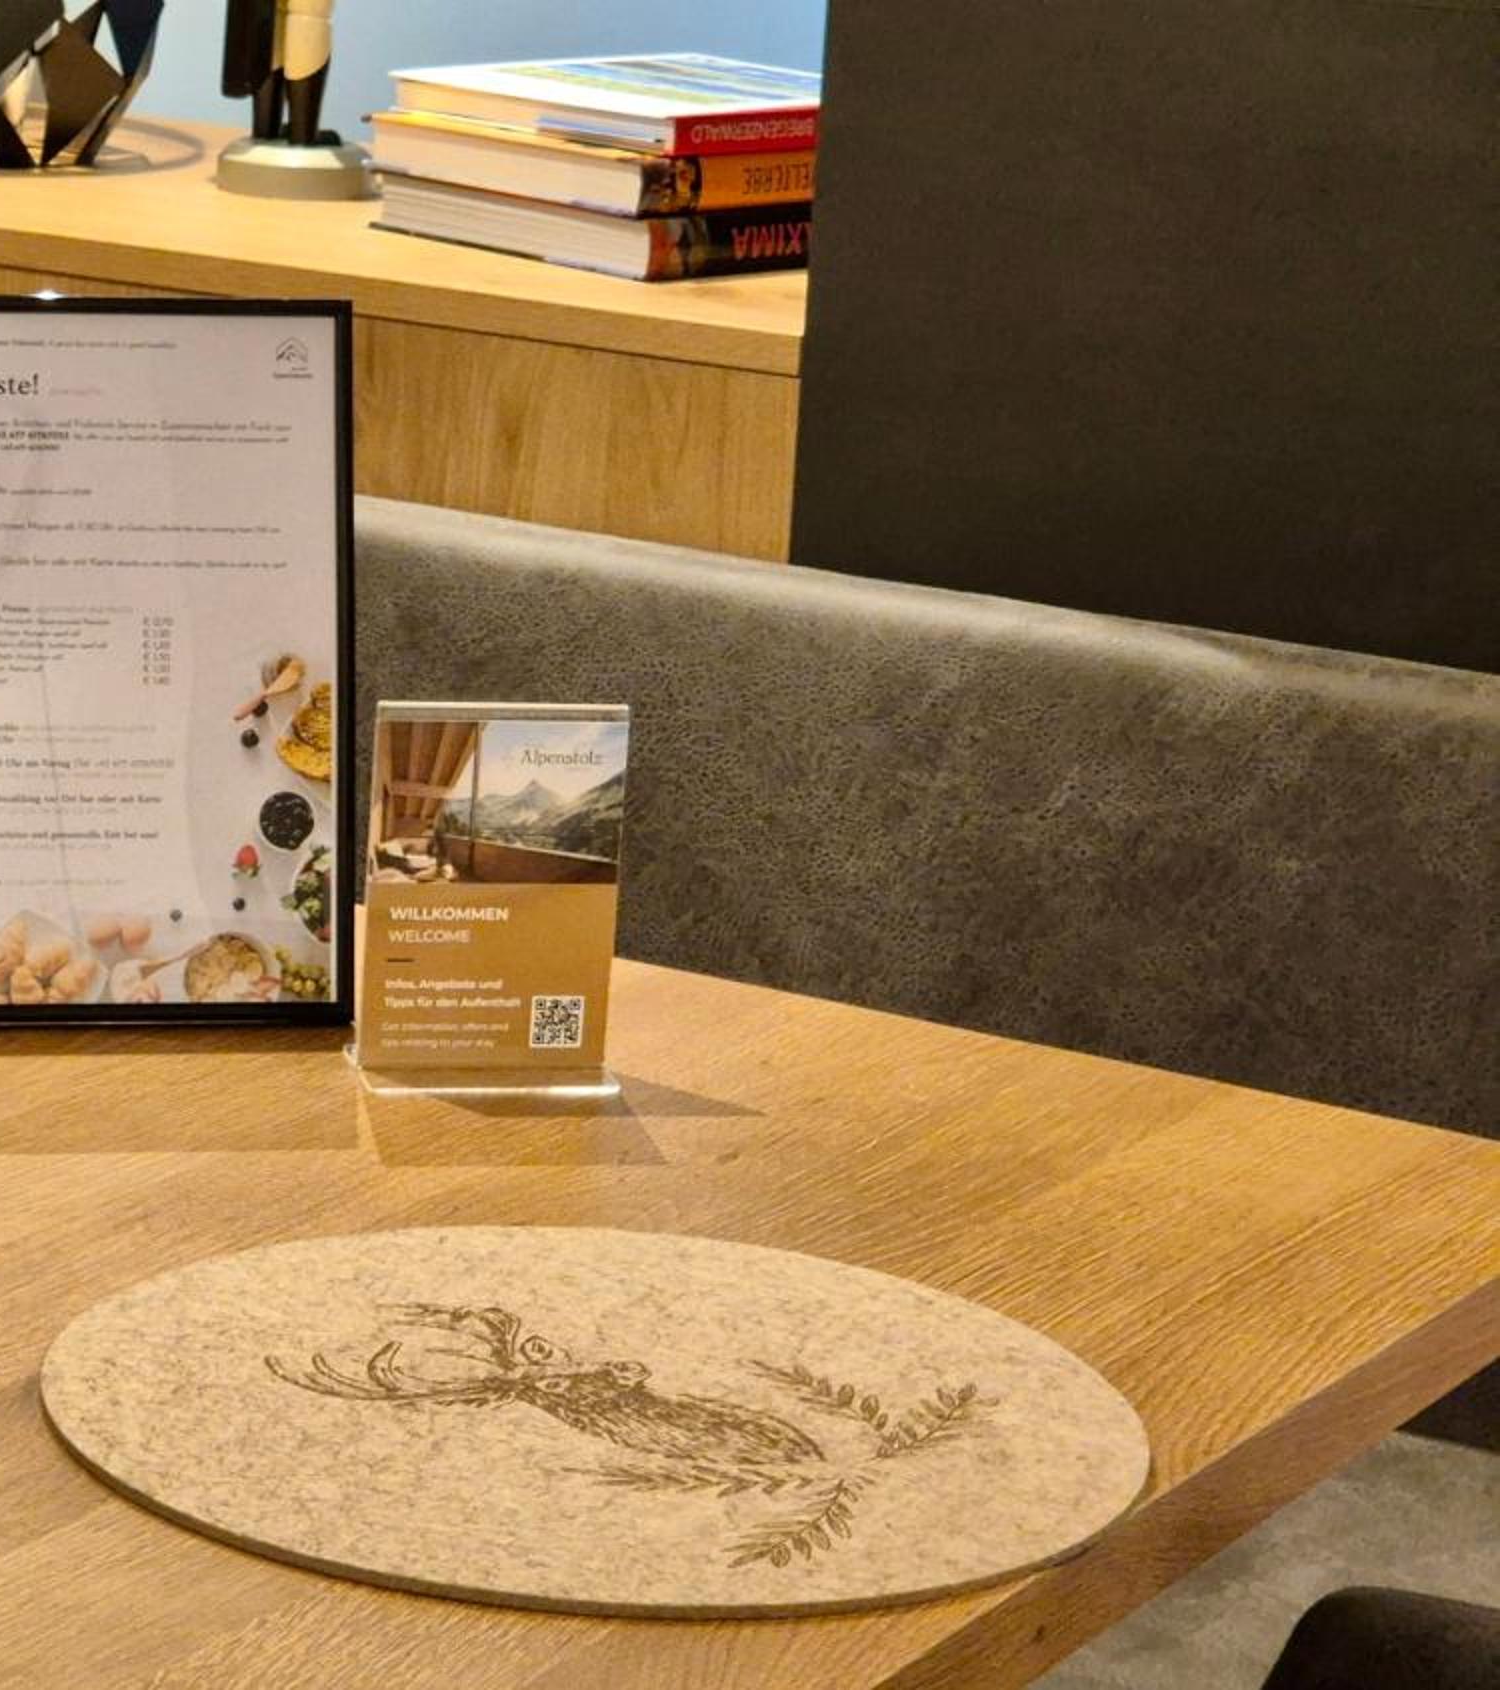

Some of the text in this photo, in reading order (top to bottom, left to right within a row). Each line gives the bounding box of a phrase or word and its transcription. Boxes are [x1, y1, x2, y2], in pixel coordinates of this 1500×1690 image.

[691, 117, 815, 144] BREGENZERWALD
[741, 163, 809, 195] ELTERBE
[520, 749, 603, 768] Alpenstolz
[389, 906, 510, 921] WILLKOMMEN
[387, 929, 471, 943] WELCOME
[419, 978, 476, 992] Angebote
[478, 978, 503, 990] und
[384, 996, 521, 1009] Tipps für den Aufenthalt
